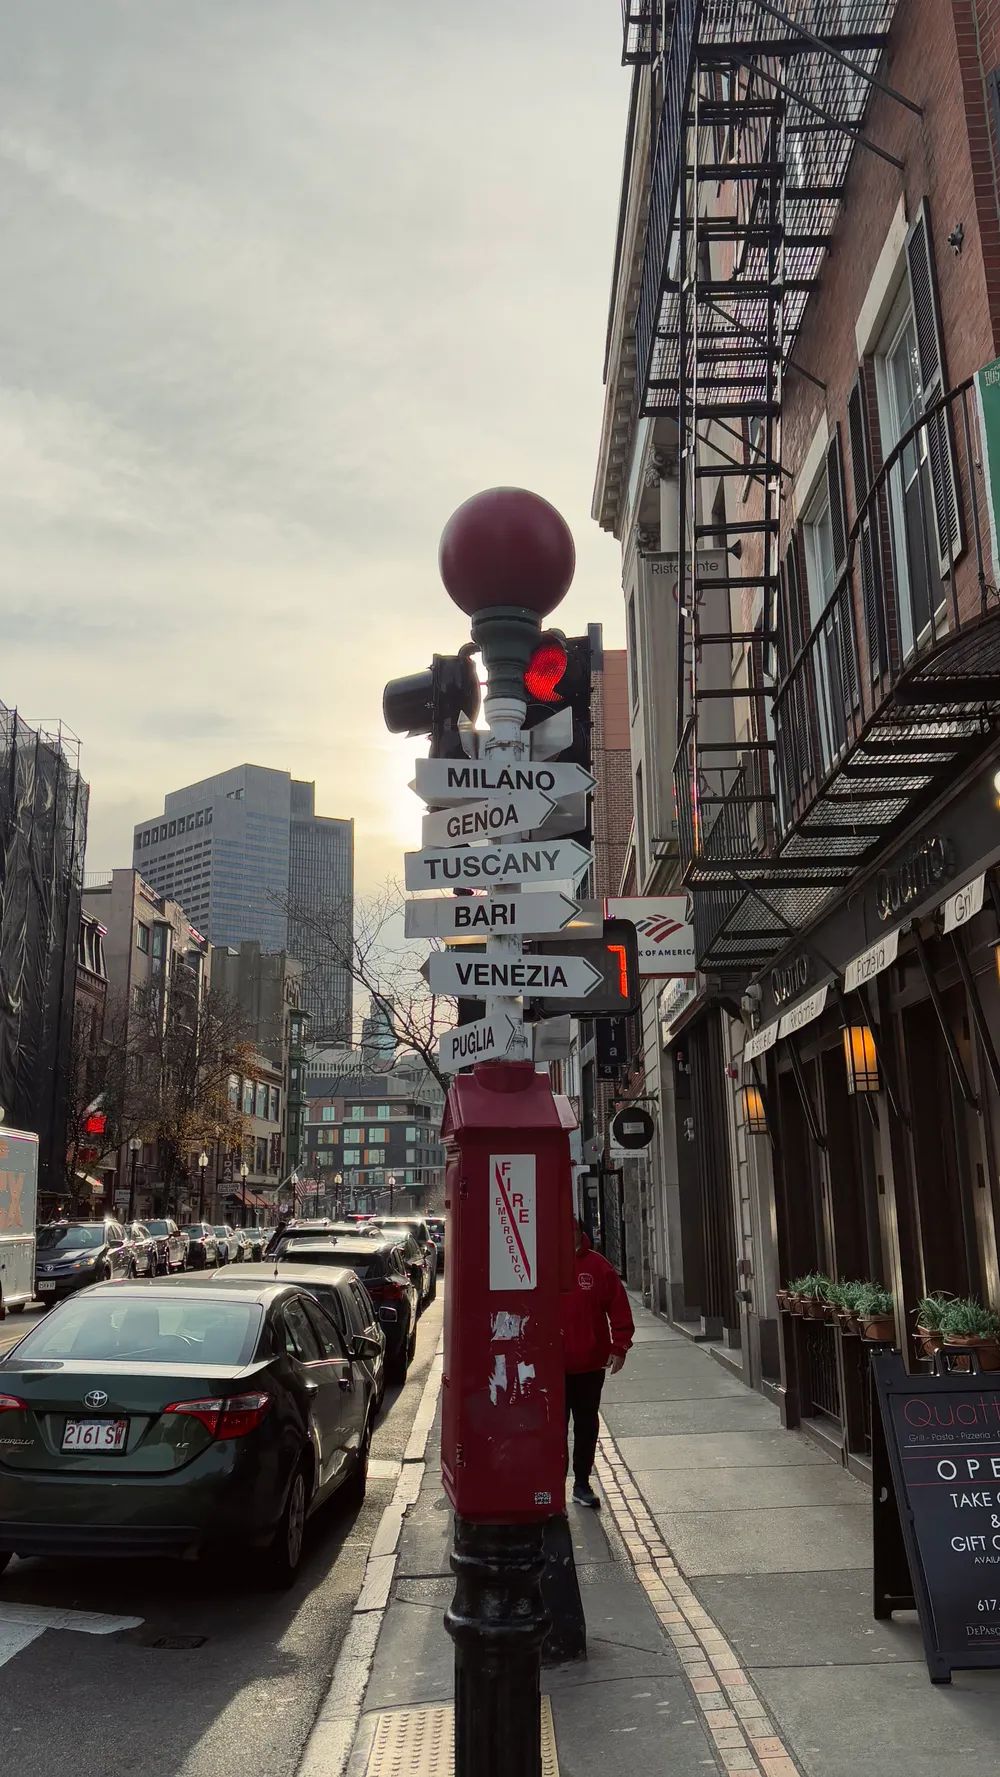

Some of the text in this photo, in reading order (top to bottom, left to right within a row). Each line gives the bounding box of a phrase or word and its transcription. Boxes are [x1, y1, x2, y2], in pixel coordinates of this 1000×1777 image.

[447, 767, 555, 791] MILANO
[446, 804, 519, 838] GENOA
[424, 849, 561, 880] TUSCANY
[454, 903, 516, 928] BARI
[645, 949, 657, 957] OF
[455, 963, 568, 988] VENEZIA
[452, 1029, 495, 1060] PUGLIA
[501, 1162, 529, 1223] FIRE
[495, 1197, 525, 1283] EMERGENCY
[65, 1426, 100, 1444] 2161
[908, 1434, 925, 1442] Grill
[931, 1433, 954, 1441] Pasta
[960, 1431, 991, 1440] Pizzeria
[950, 1492, 993, 1508] TAKE
[951, 1535, 986, 1551] GIFT
